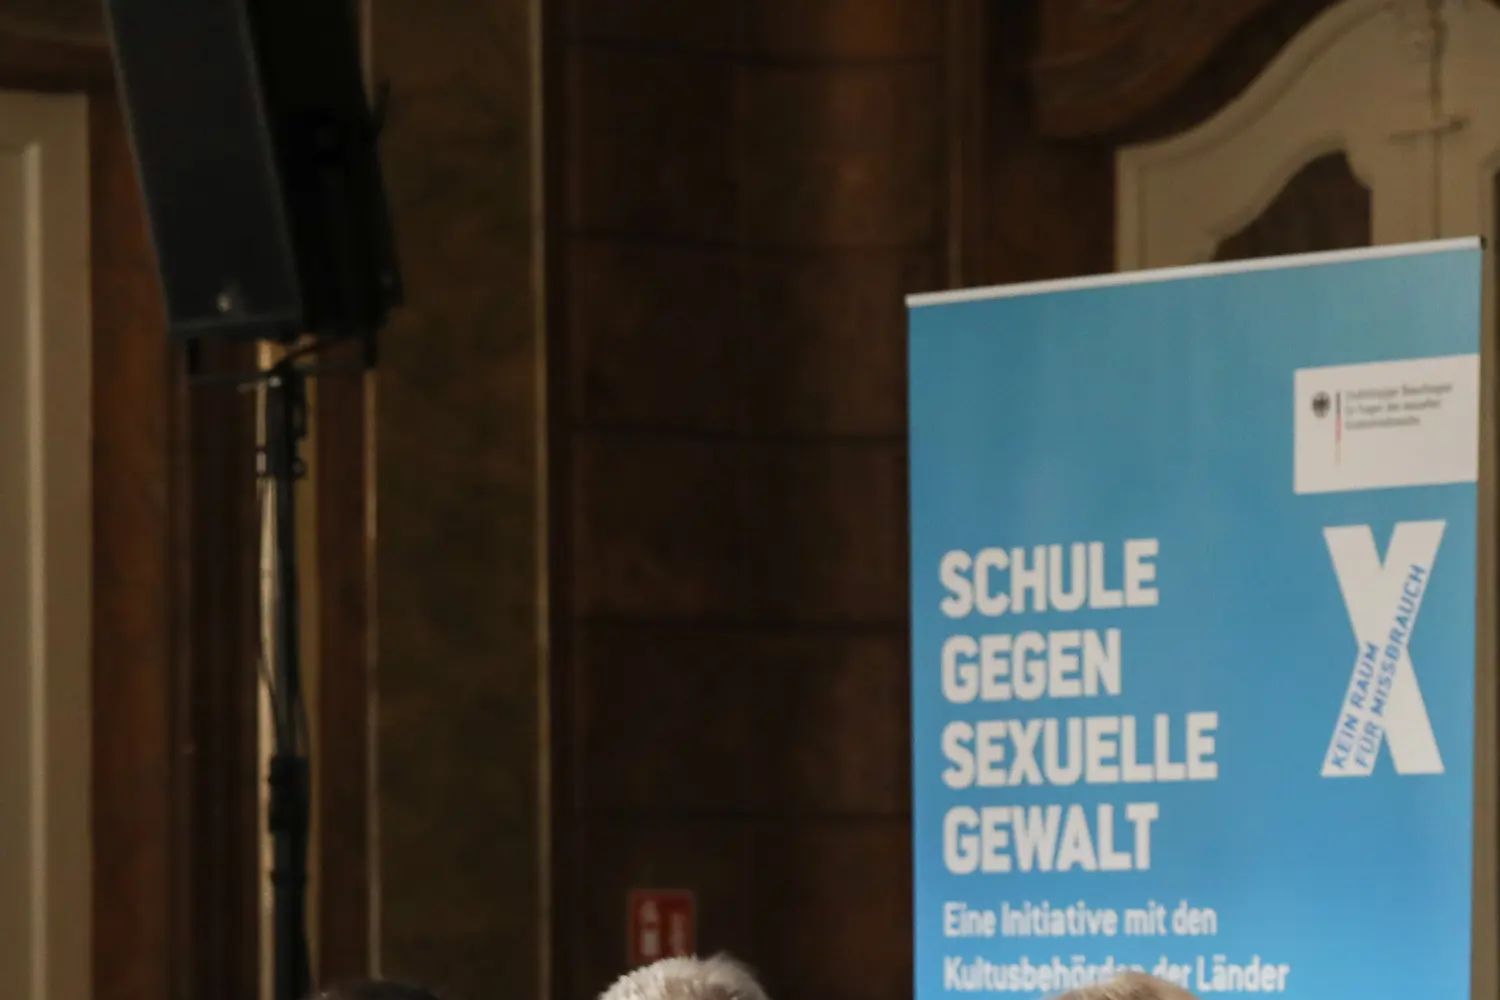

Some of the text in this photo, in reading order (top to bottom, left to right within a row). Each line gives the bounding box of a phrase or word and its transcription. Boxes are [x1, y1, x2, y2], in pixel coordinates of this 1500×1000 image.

[939, 538, 1159, 617] SCHULE
[942, 628, 1121, 703] GEGEN
[1354, 564, 1427, 768] FÜR MISSBRAUCH
[1331, 640, 1379, 769] KEIN RAUM
[941, 711, 1219, 788] SEXUELLE
[943, 802, 1158, 874] GEWALT
[944, 900, 1218, 937] Eine Initiative mit den
[944, 954, 1290, 992] Kultusbehörd der Länder
